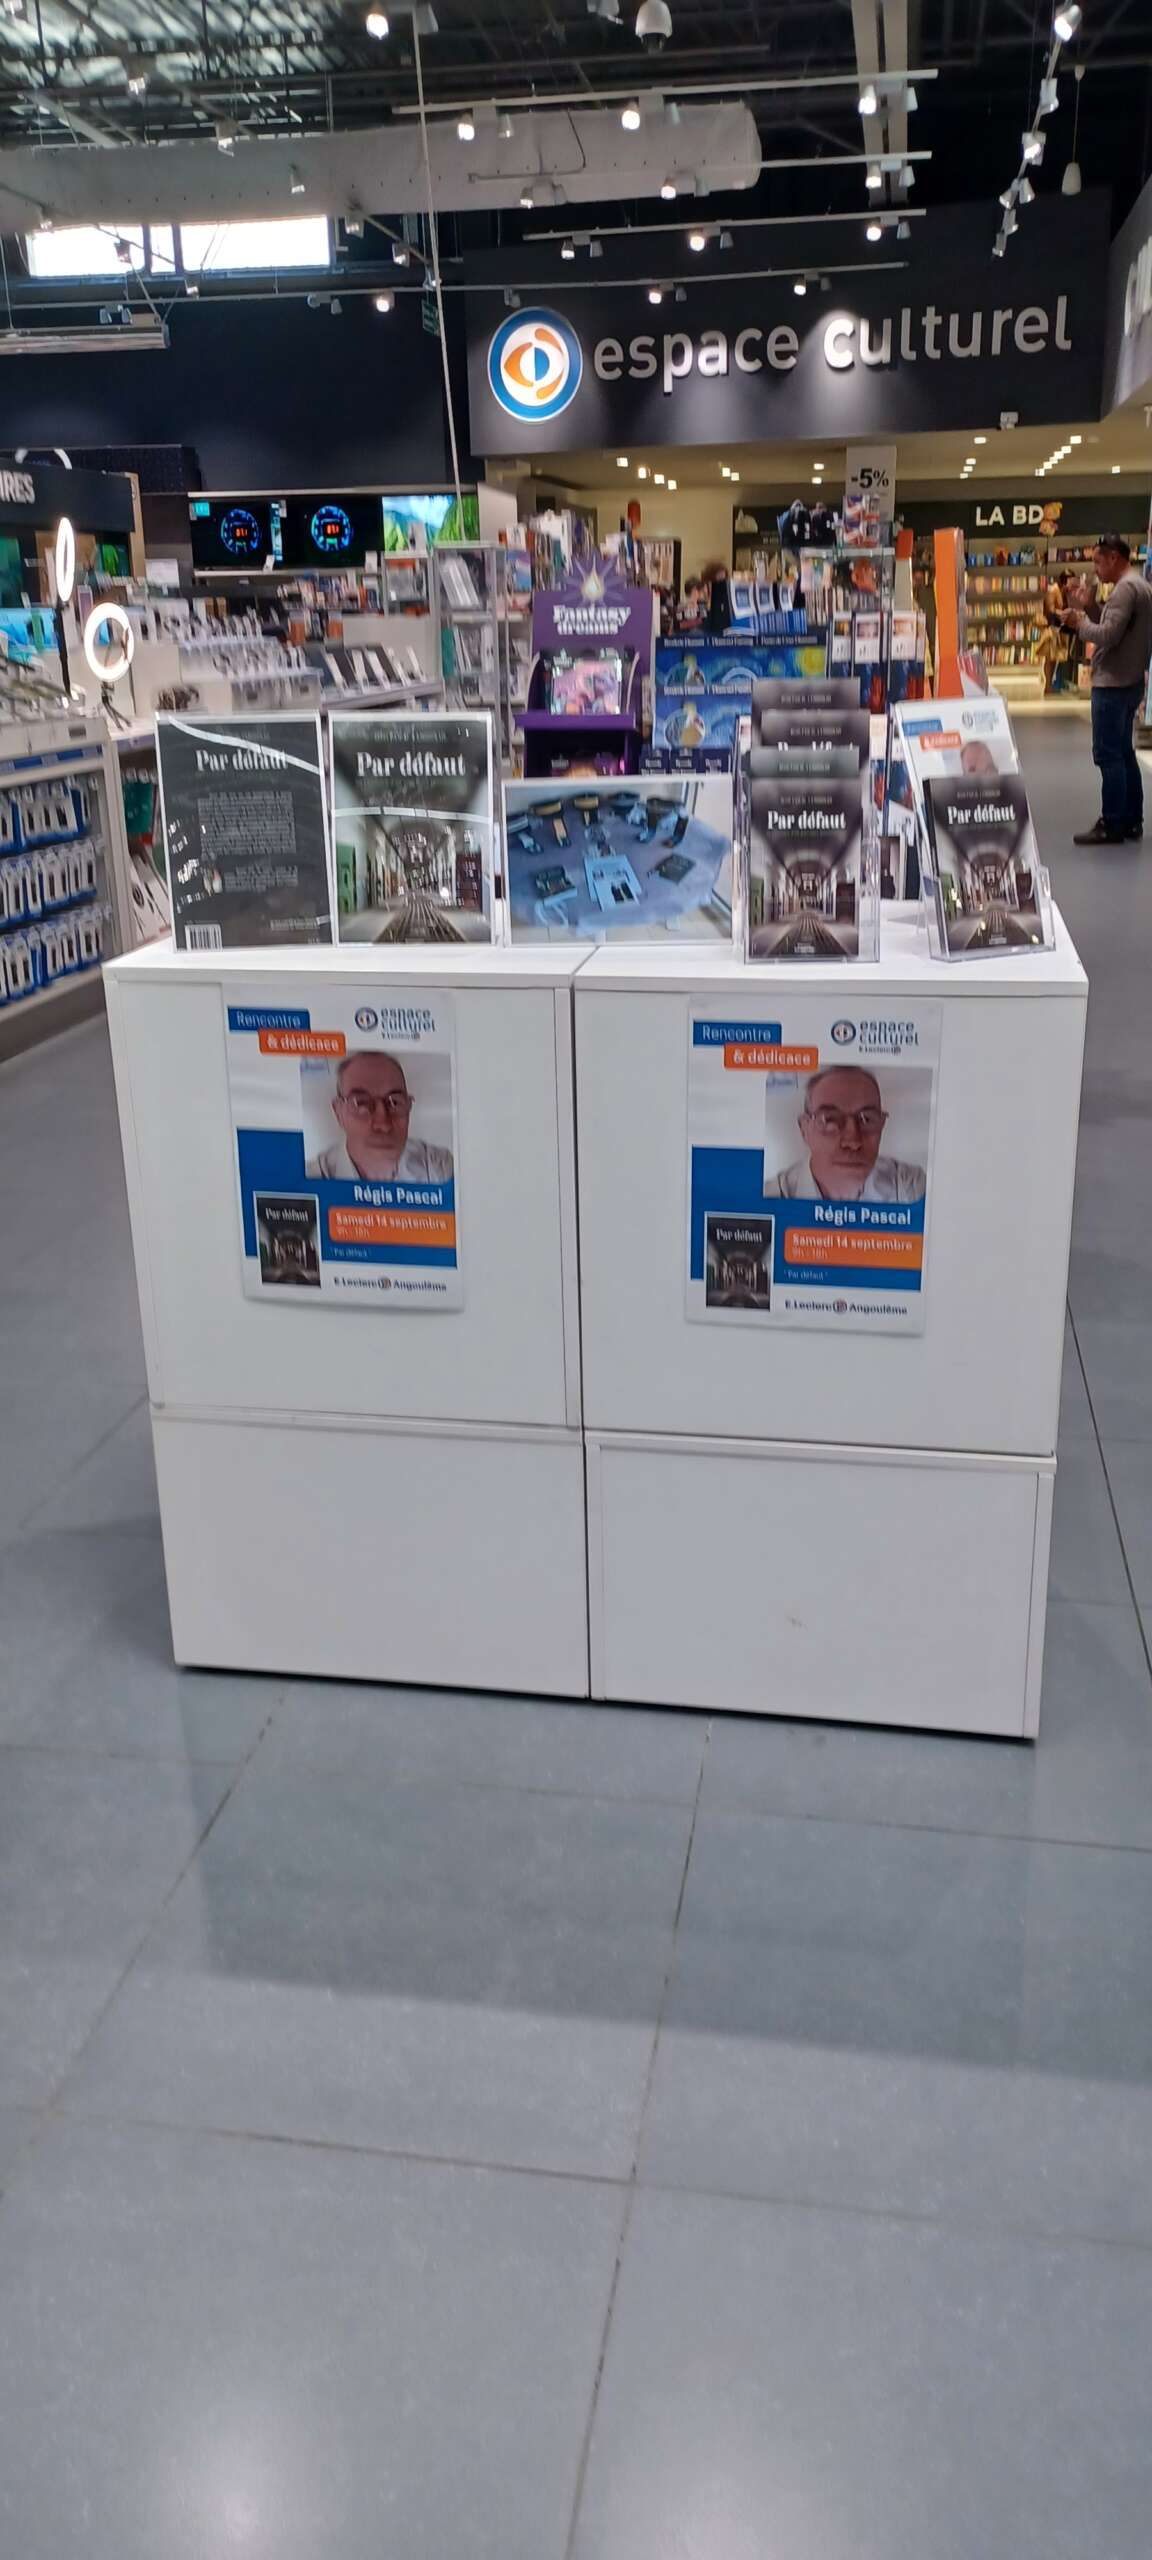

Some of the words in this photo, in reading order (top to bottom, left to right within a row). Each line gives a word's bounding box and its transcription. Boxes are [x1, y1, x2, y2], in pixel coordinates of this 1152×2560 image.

[592, 323, 798, 393] espace
[823, 296, 1072, 369] culturel
[851, 468, 889, 488] -5%
[976, 505, 1005, 526] LA
[1013, 505, 1044, 525] BD
[553, 605, 631, 626] Fantasy
[557, 622, 618, 635] dreams
[196, 749, 228, 772] Par
[357, 751, 395, 777] Par
[400, 751, 466, 777] défaut
[768, 810, 795, 830] Par
[798, 810, 847, 830] défaut
[947, 804, 972, 825] Par
[973, 803, 1016, 823] défaut
[236, 1010, 301, 1028] Rencontre
[859, 1020, 914, 1034] espace
[266, 1034, 278, 1050] &
[281, 1035, 340, 1052] dédicace
[702, 1024, 772, 1042] Rencontre
[733, 1048, 744, 1064] &
[747, 1049, 811, 1067] dédicace
[353, 1184, 393, 1206] Régis
[396, 1187, 443, 1206] Pascal
[335, 1212, 374, 1227] Samedi
[814, 1205, 856, 1226] Régis
[861, 1208, 911, 1226] Pascal
[792, 1233, 834, 1248] Samedi
[836, 1236, 848, 1248] 14
[850, 1237, 913, 1254] septembre
